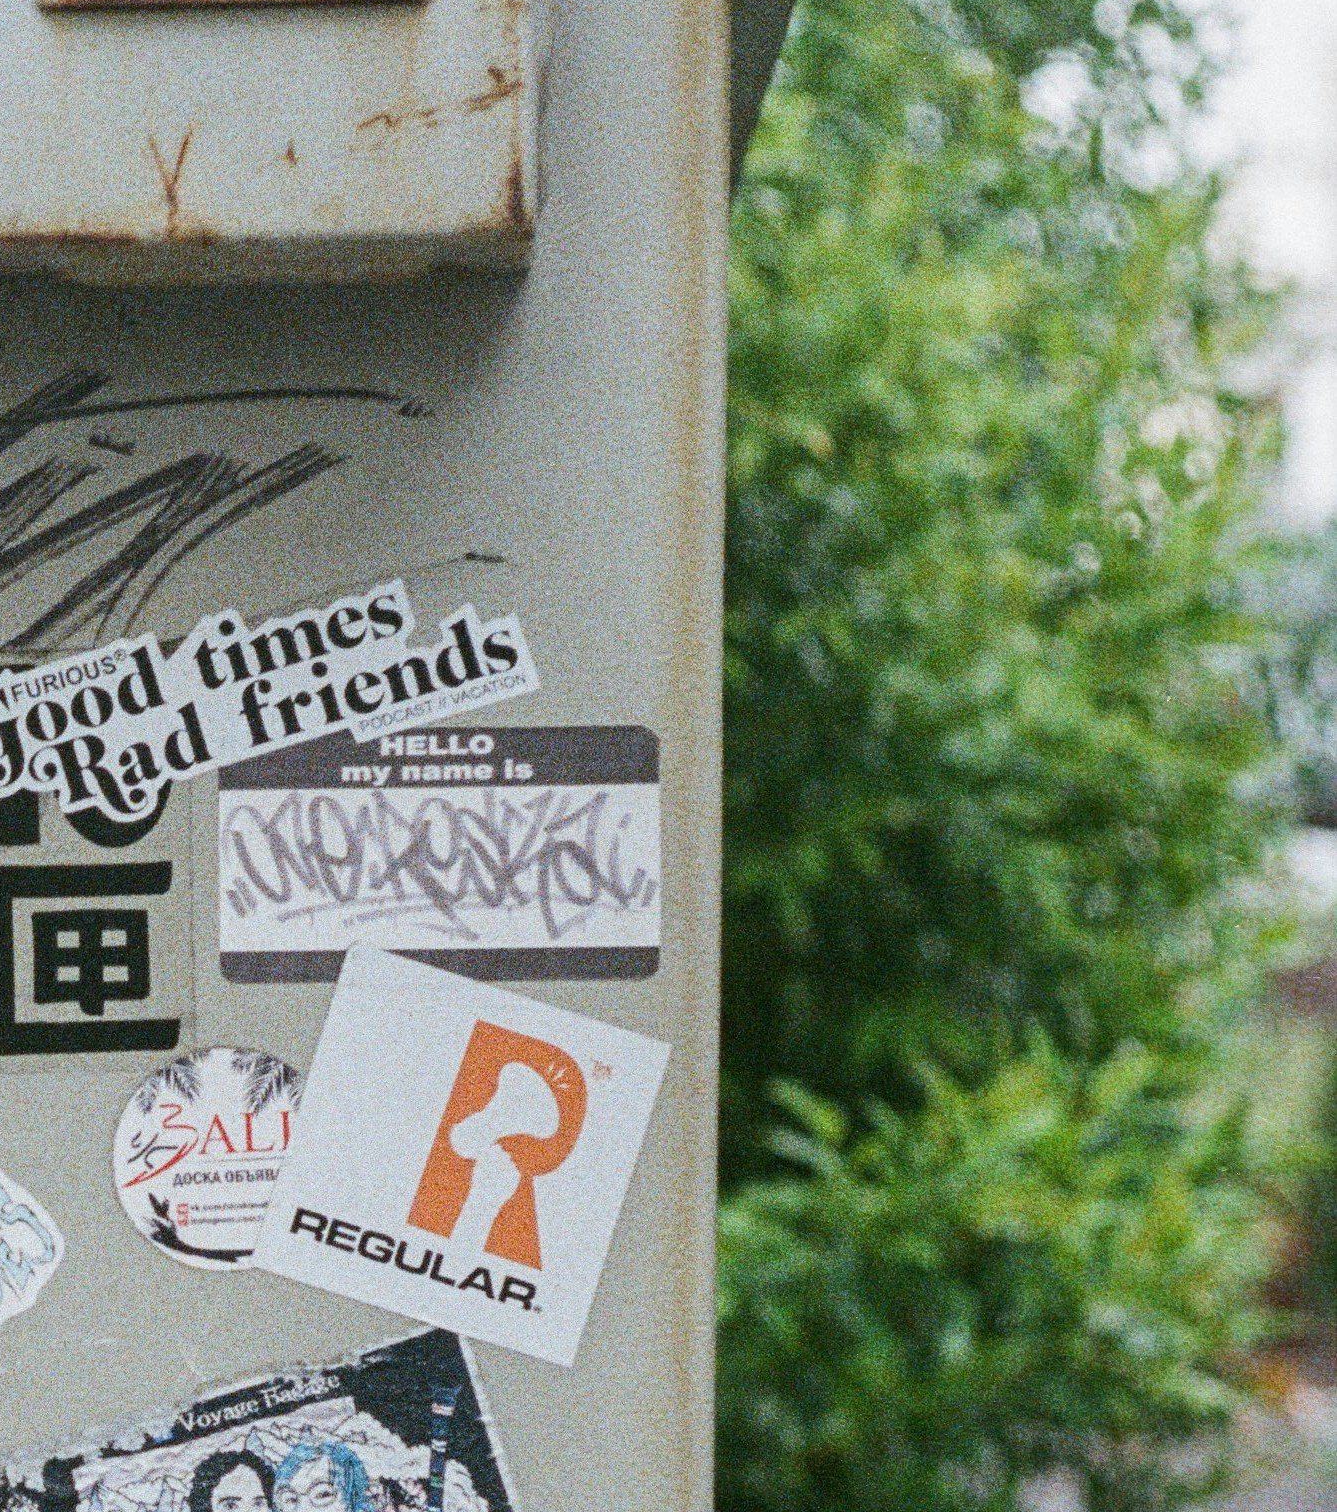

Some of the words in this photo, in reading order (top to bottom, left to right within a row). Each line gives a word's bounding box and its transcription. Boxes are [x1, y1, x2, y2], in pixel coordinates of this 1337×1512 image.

[193, 593, 405, 691] times
[28, 701, 214, 814] Rad
[239, 617, 520, 746] friends
[357, 699, 434, 735] PODCAST
[448, 674, 528, 709] VACATION
[380, 733, 495, 756] HELLO
[341, 764, 391, 786] my
[402, 763, 494, 782] name
[504, 758, 534, 780] is
[172, 1171, 222, 1189] ДОСКА
